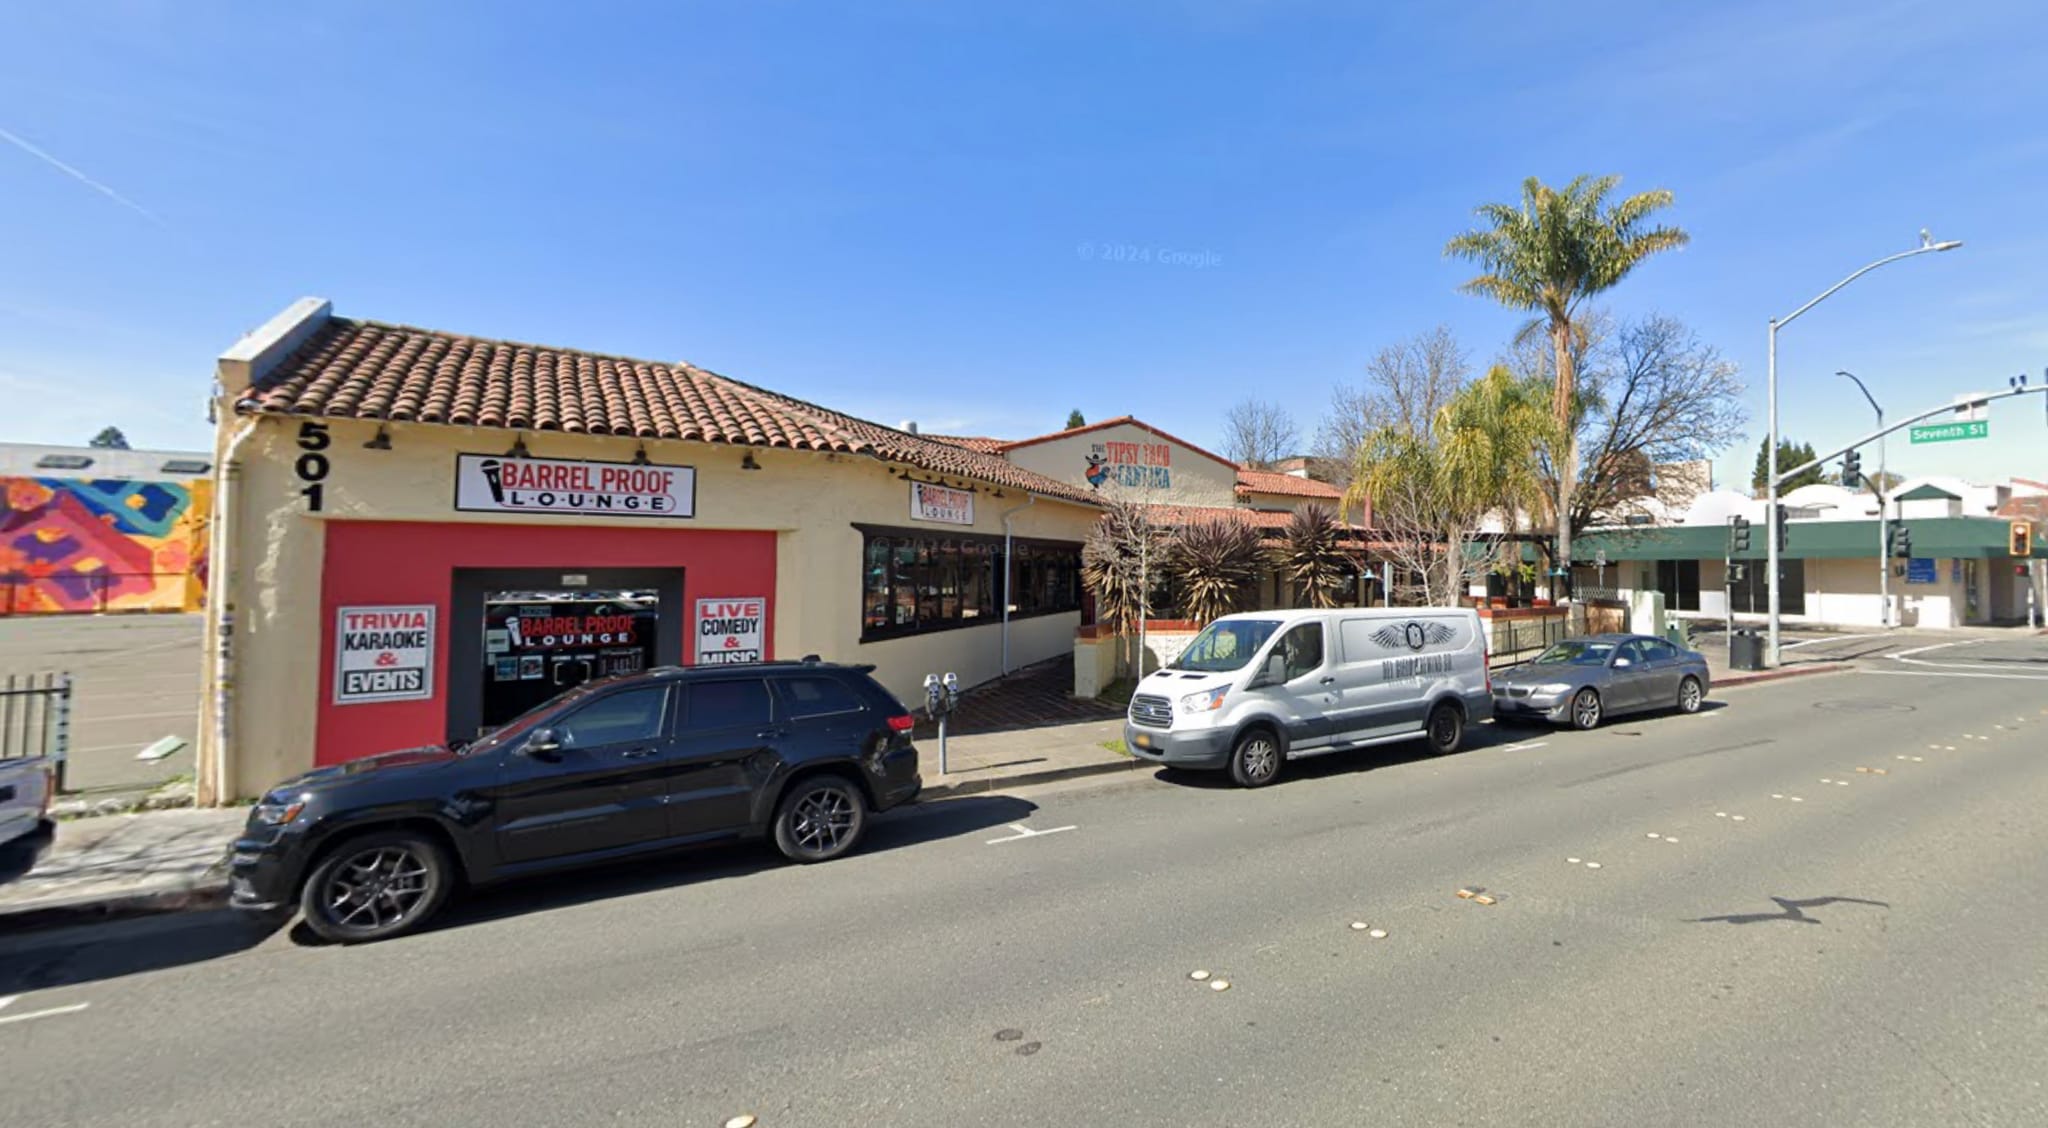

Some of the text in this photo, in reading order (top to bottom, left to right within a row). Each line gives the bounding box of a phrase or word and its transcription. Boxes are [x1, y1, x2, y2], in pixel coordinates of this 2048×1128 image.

[1912, 423, 1985, 440] Seventh St
[1106, 441, 1140, 465] TIPSY
[1143, 443, 1170, 467] TACO
[295, 421, 331, 511] 501
[502, 462, 674, 494] BARREL PROOF
[701, 603, 760, 618] LIVE
[345, 612, 426, 630] TRIVIA
[521, 615, 636, 636] BARREL PROOF
[701, 618, 759, 636] COMEDY
[344, 631, 427, 651] KARAOKE
[724, 636, 740, 649] &
[375, 651, 399, 667] &
[346, 670, 420, 693] EVENTS
